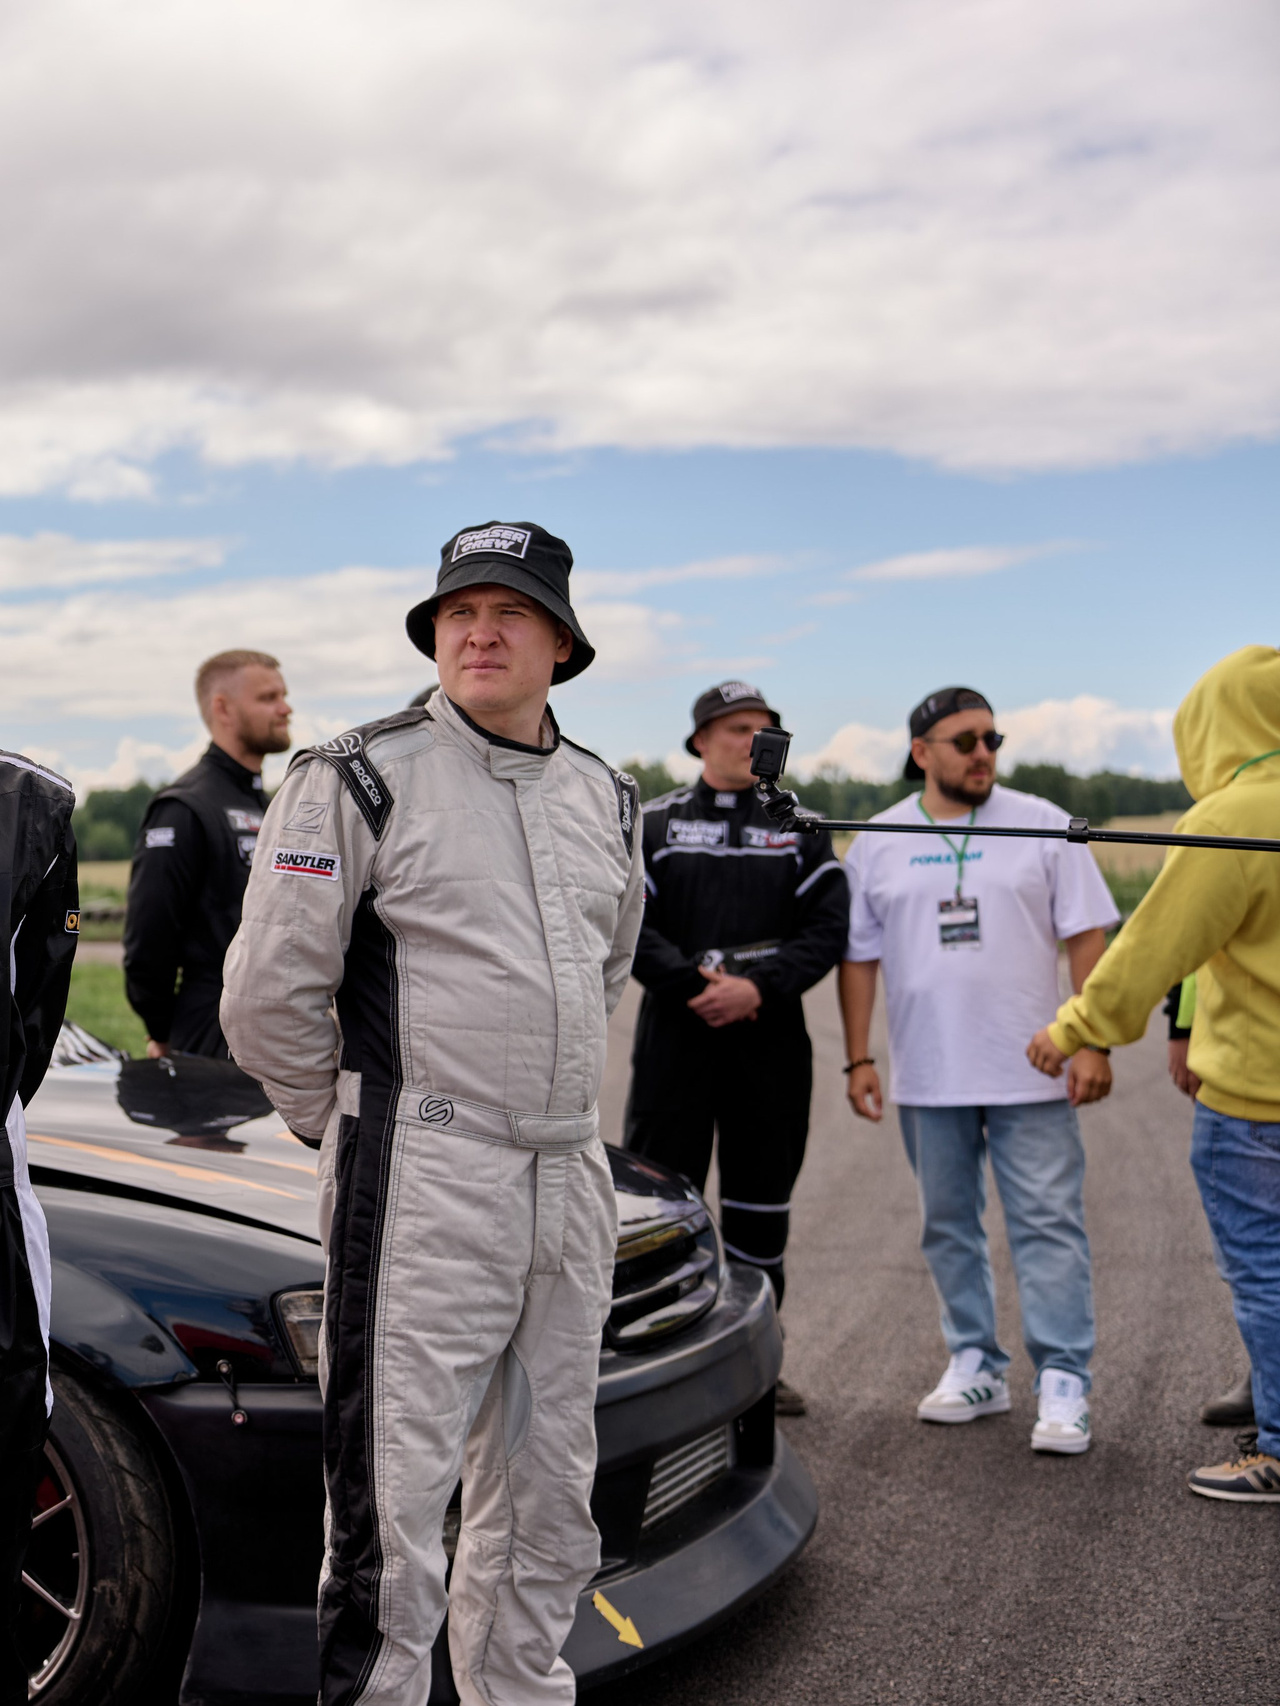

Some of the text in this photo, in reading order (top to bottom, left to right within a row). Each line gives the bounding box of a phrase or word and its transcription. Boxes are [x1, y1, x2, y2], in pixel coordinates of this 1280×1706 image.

[459, 528, 526, 546] CHASER
[461, 538, 515, 553] CREW
[275, 852, 336, 871] SANDTLER
[67, 913, 80, 930] O
